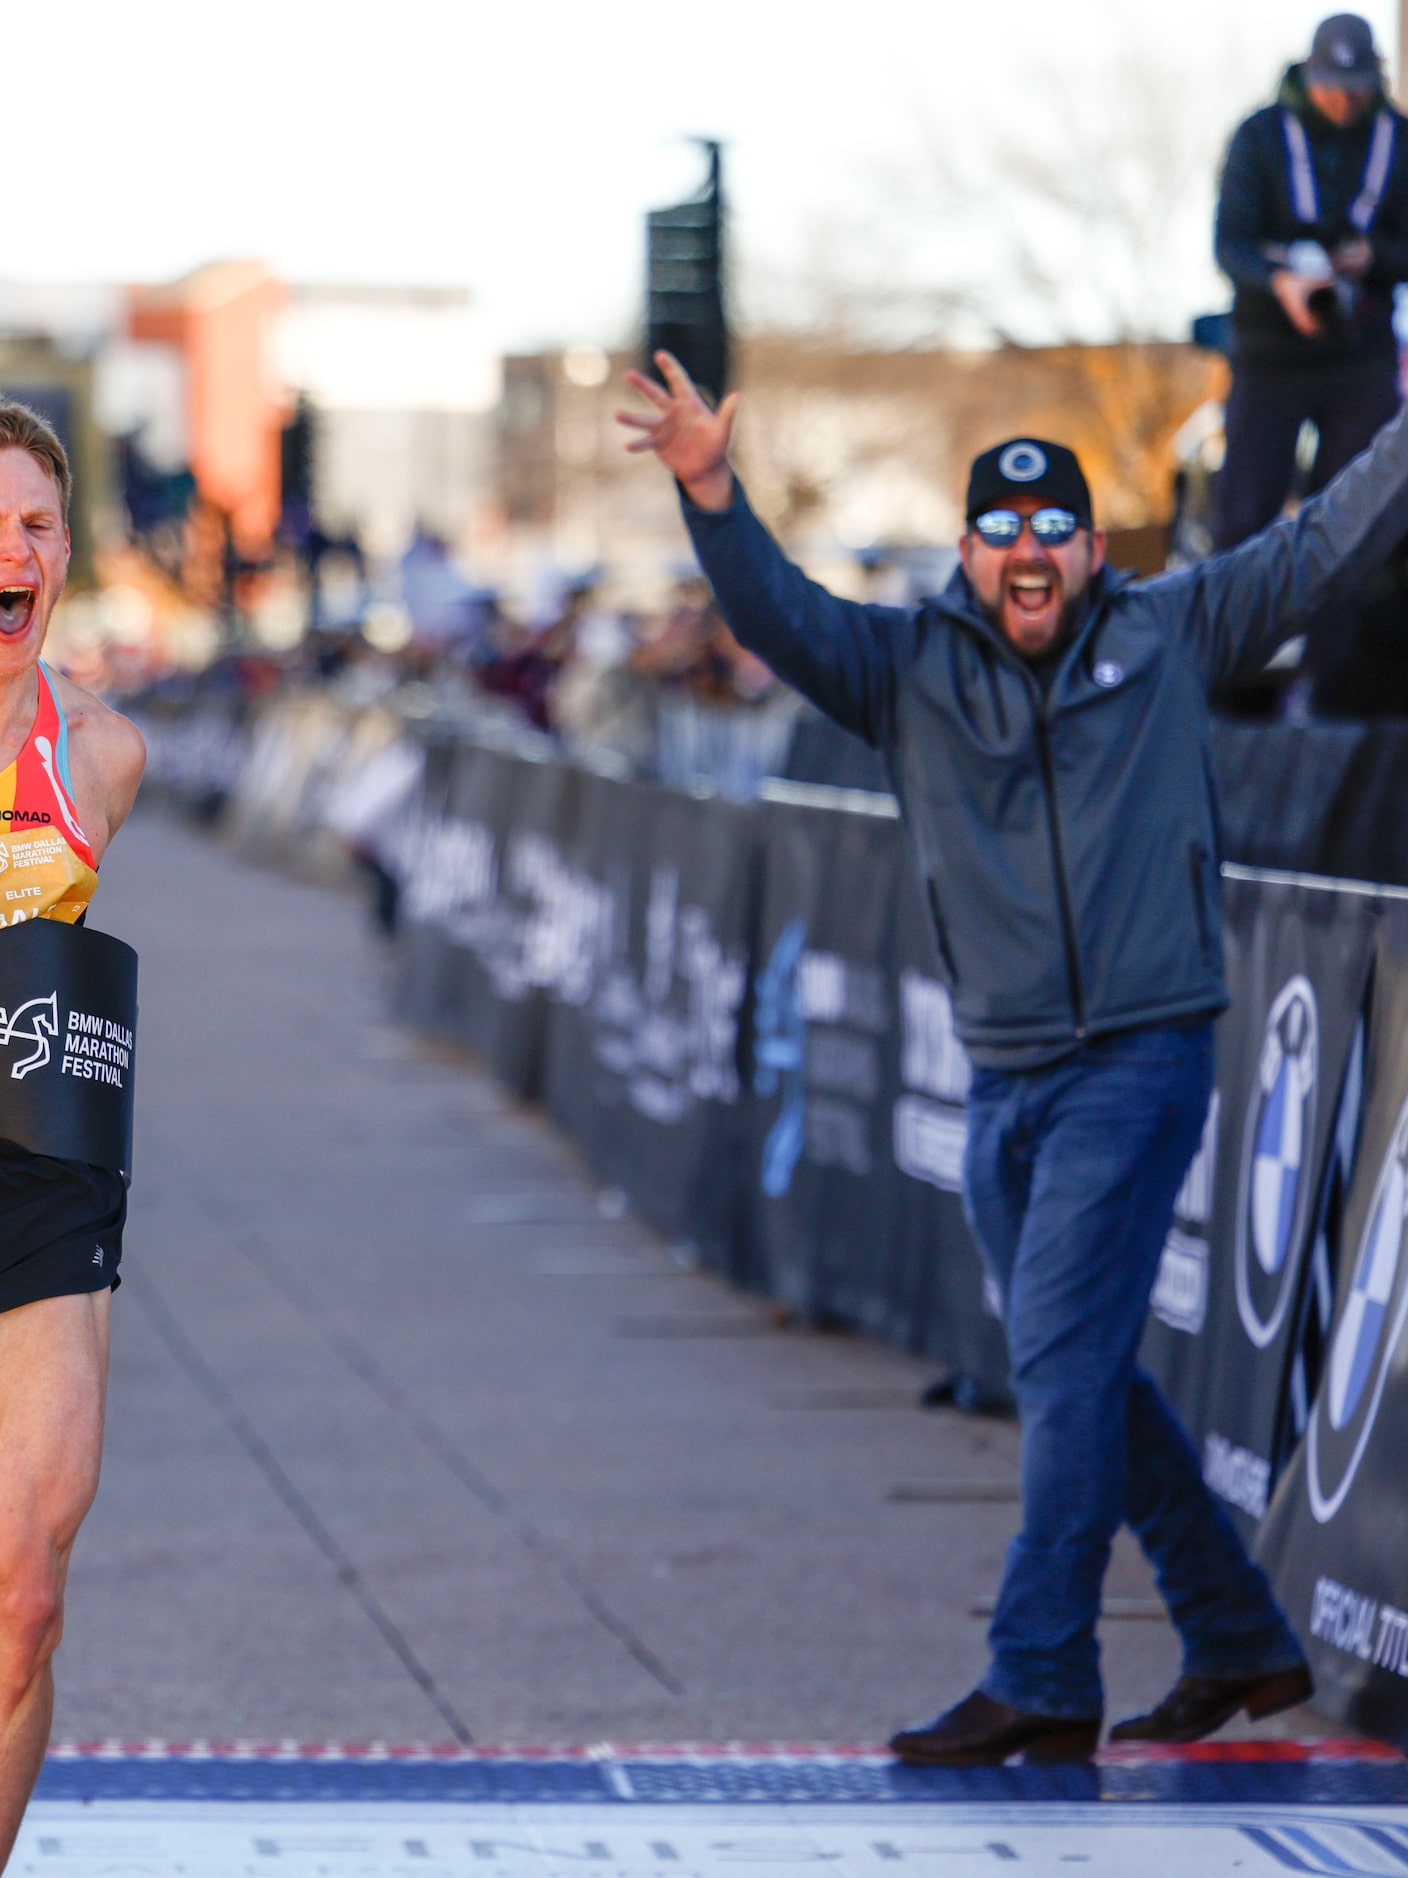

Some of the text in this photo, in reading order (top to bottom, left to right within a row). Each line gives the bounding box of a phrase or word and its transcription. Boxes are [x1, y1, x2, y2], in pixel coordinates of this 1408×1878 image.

[11, 837, 67, 853] BMW DALLAS
[12, 846, 62, 861] MARATHON
[13, 856, 55, 868] FESTIVAL
[5, 887, 42, 900] ELITE
[68, 1011, 133, 1050] BMW DALLAS
[65, 1033, 129, 1069] MARATHON
[61, 1055, 123, 1088] FESTIVAL
